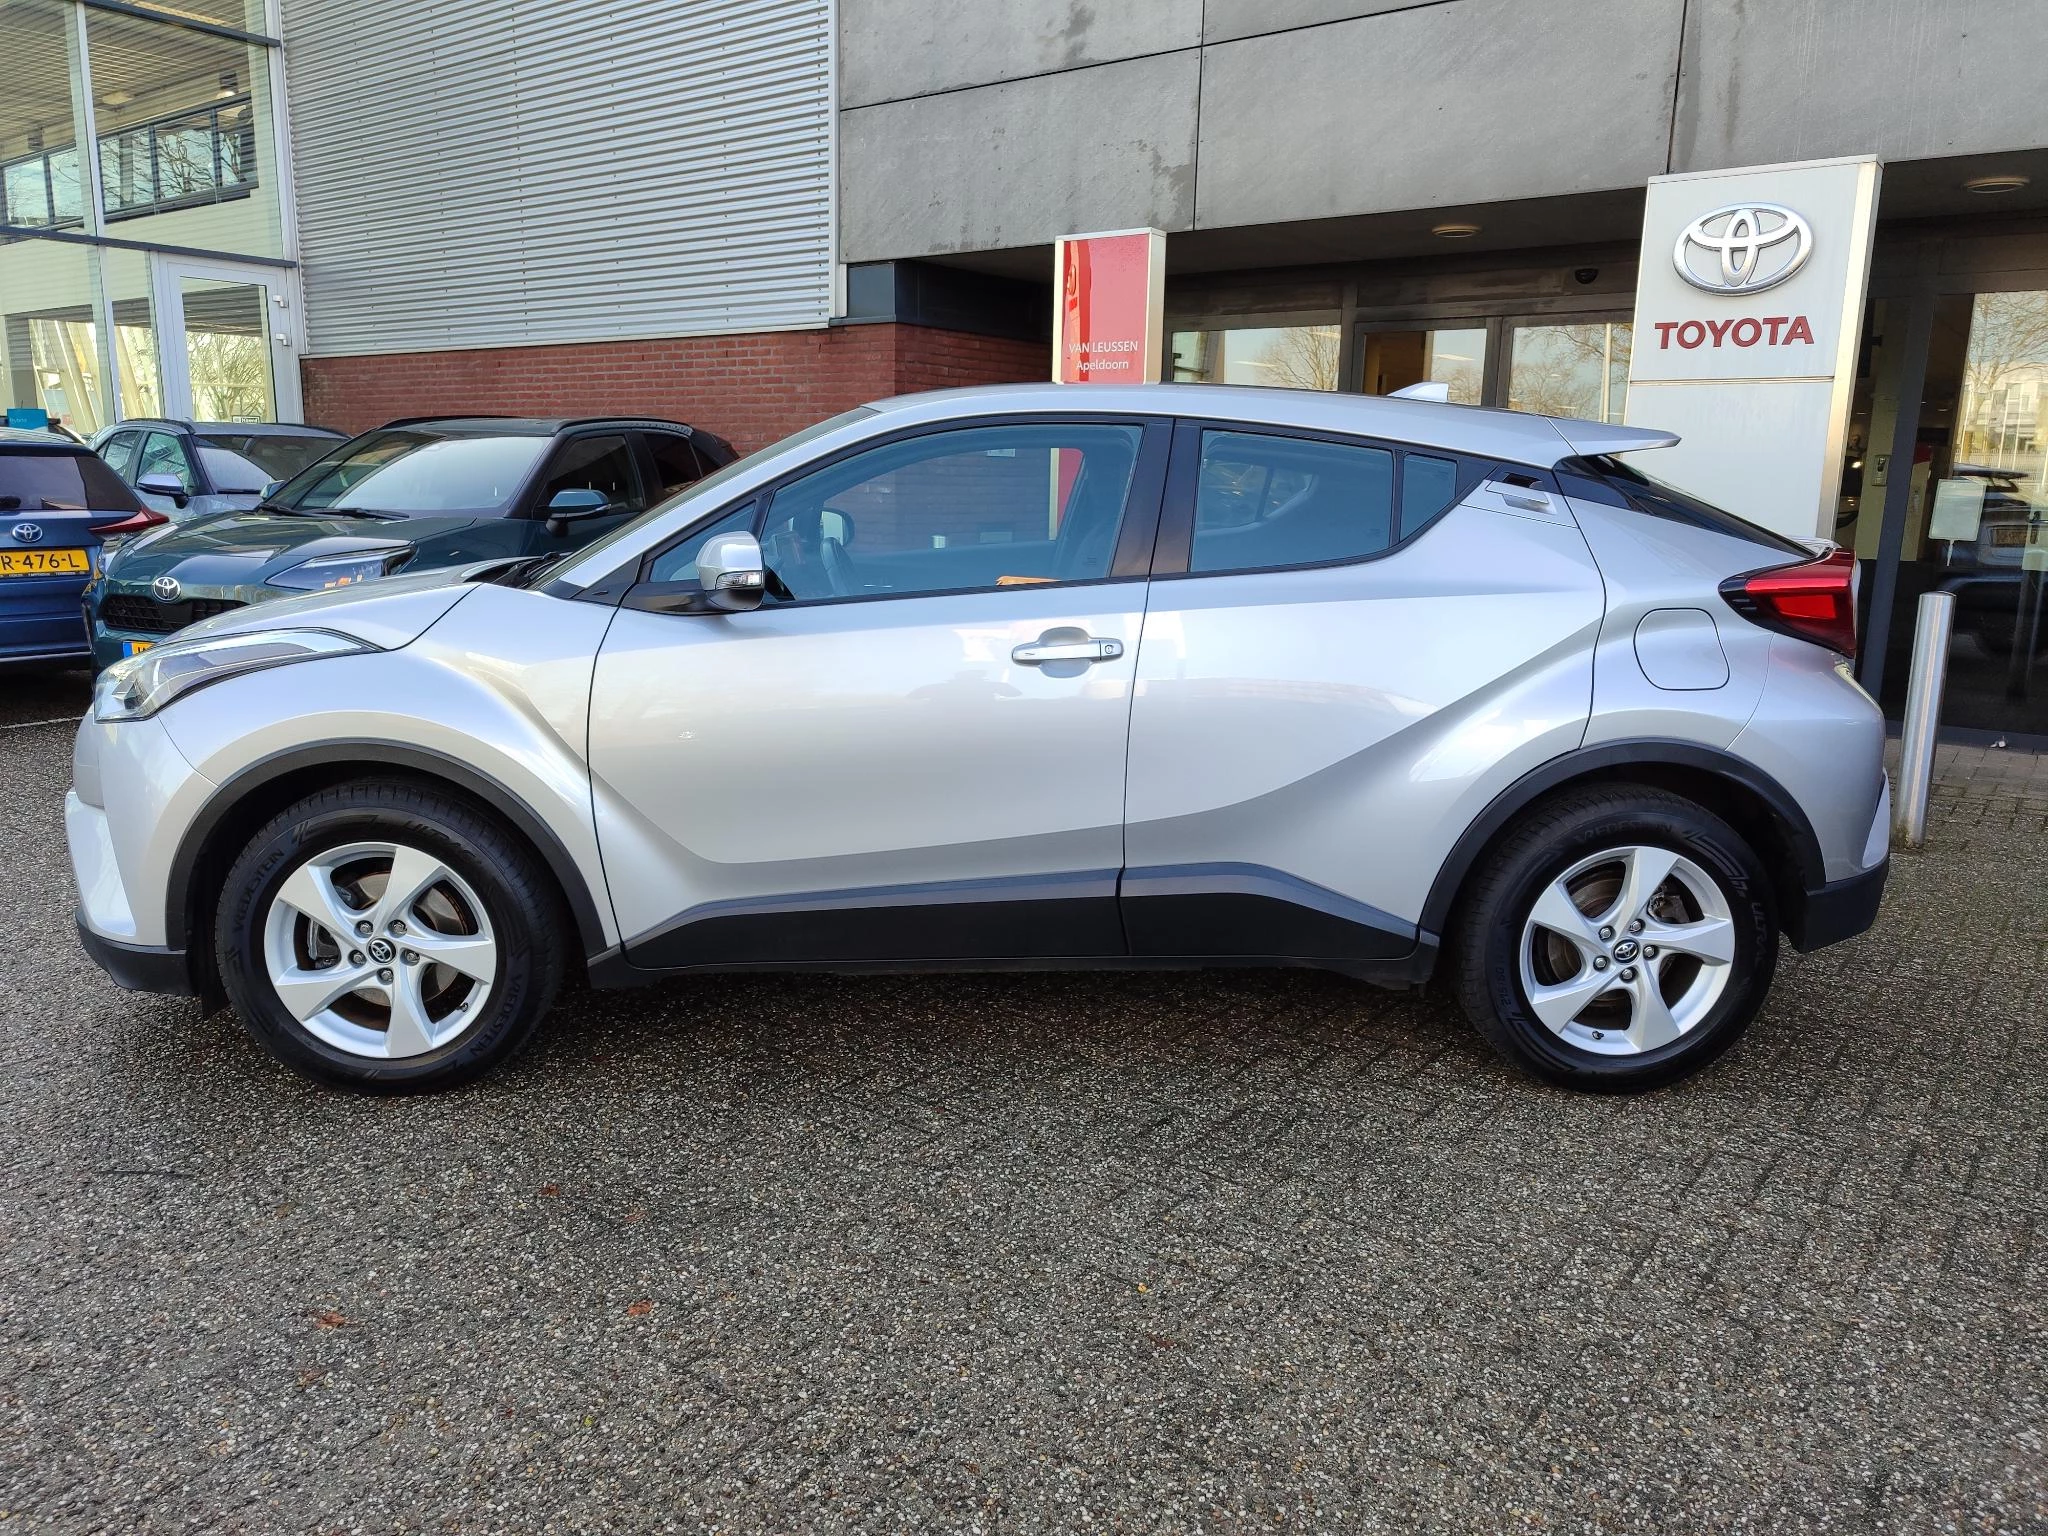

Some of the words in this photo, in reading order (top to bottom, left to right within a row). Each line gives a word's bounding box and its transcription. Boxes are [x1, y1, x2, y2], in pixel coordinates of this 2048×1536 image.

[1655, 316, 1814, 349] TOYOTA
[1069, 342, 1090, 353] VAN
[1092, 341, 1138, 353] LEUSSEN
[1076, 360, 1129, 373] Apeldoorn
[0, 553, 80, 570] R-476-L
